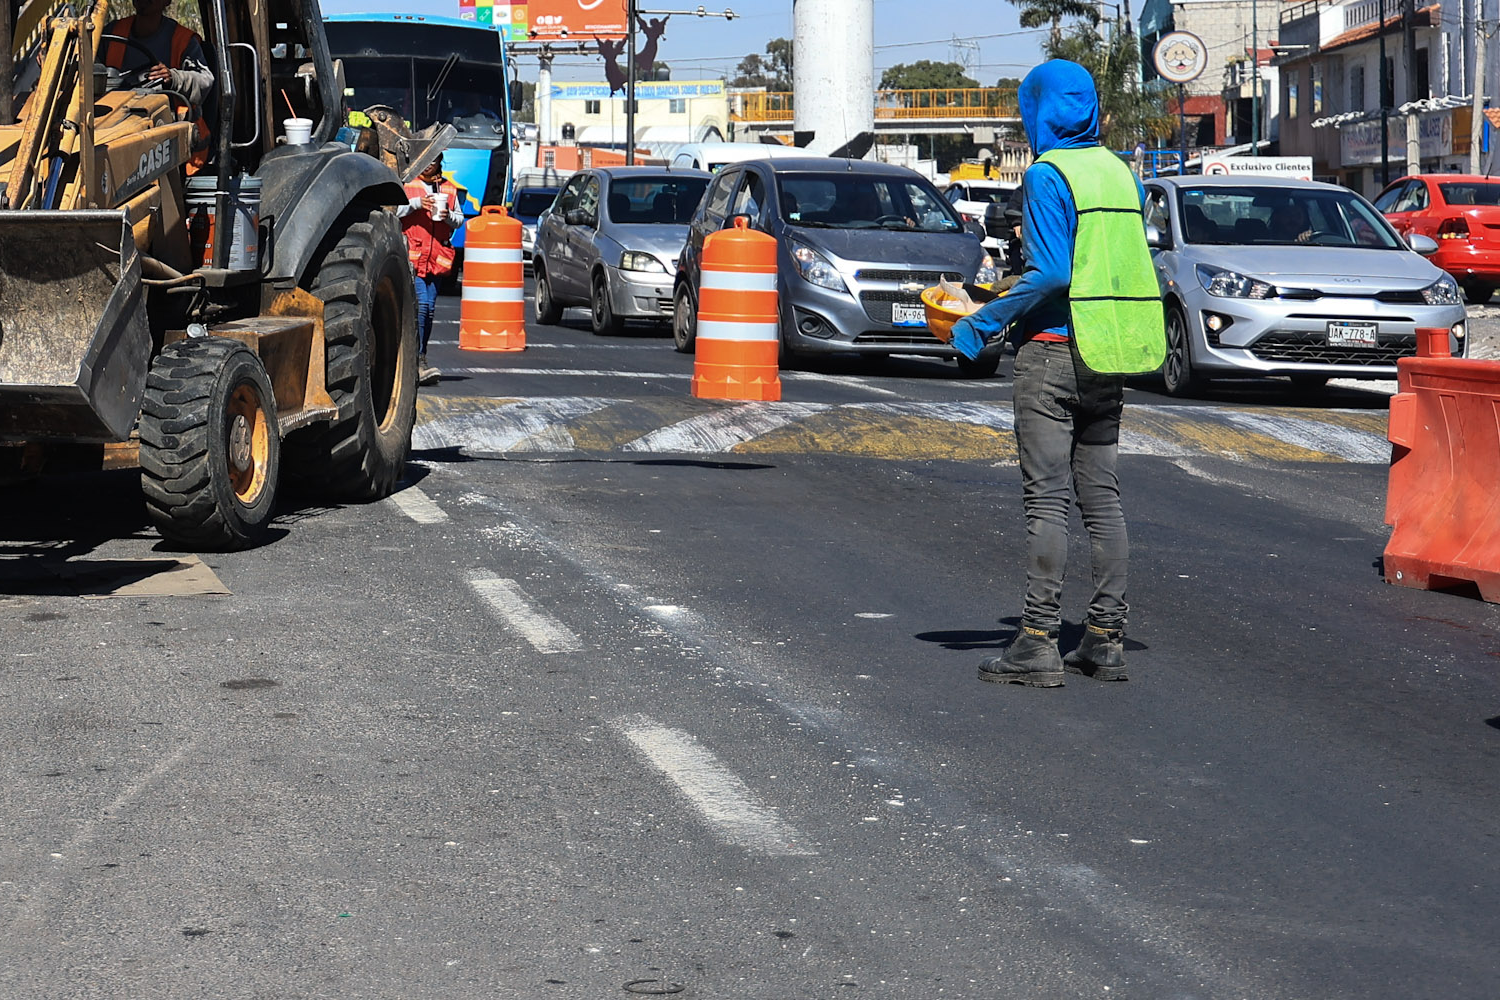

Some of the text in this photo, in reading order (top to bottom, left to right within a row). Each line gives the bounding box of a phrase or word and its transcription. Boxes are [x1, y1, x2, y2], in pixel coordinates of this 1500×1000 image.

[138, 138, 171, 179] CASE
[1230, 162, 1311, 171] Exclusivo Clientes
